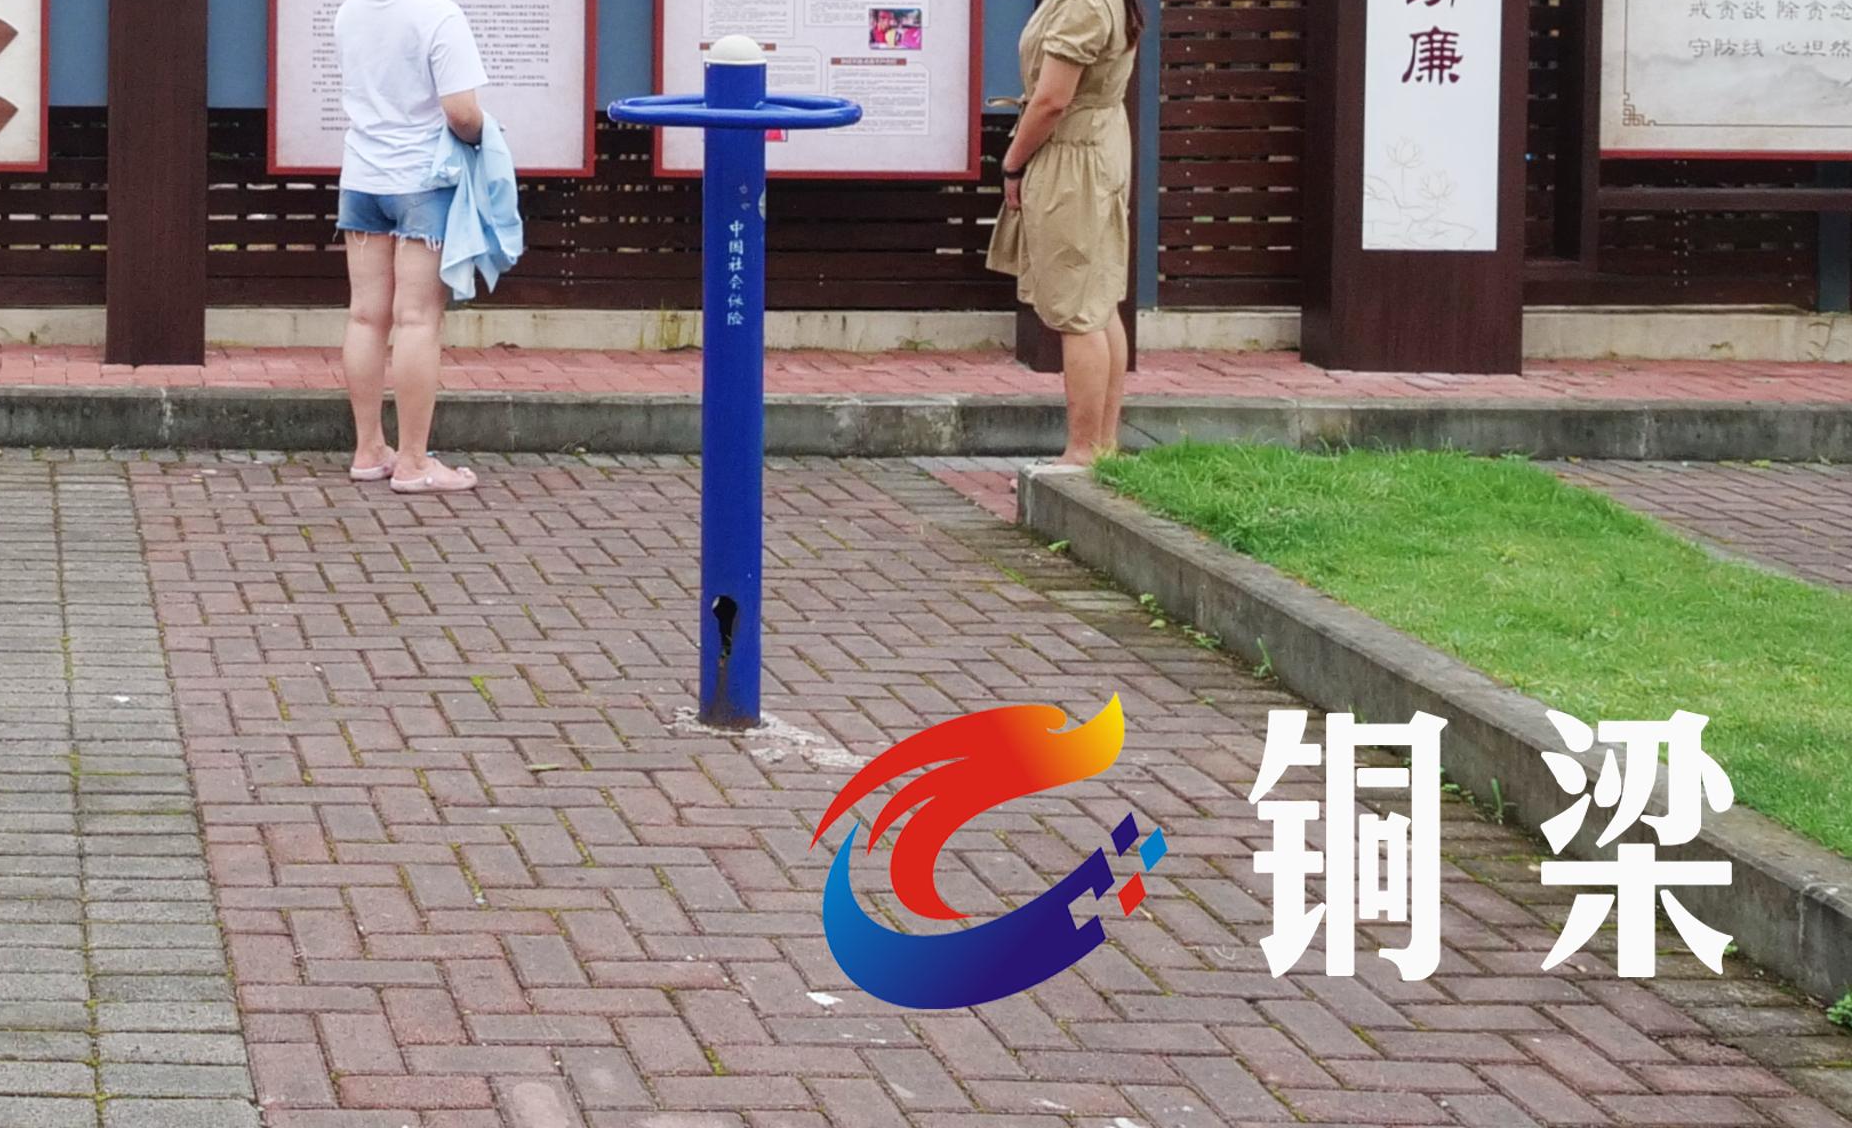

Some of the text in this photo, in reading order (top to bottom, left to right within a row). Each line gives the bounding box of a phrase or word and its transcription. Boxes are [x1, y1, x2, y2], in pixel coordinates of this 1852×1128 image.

[1688, 0, 1766, 20] 戒贪欲
[1688, 38, 1852, 59] 守防线 心坦然
